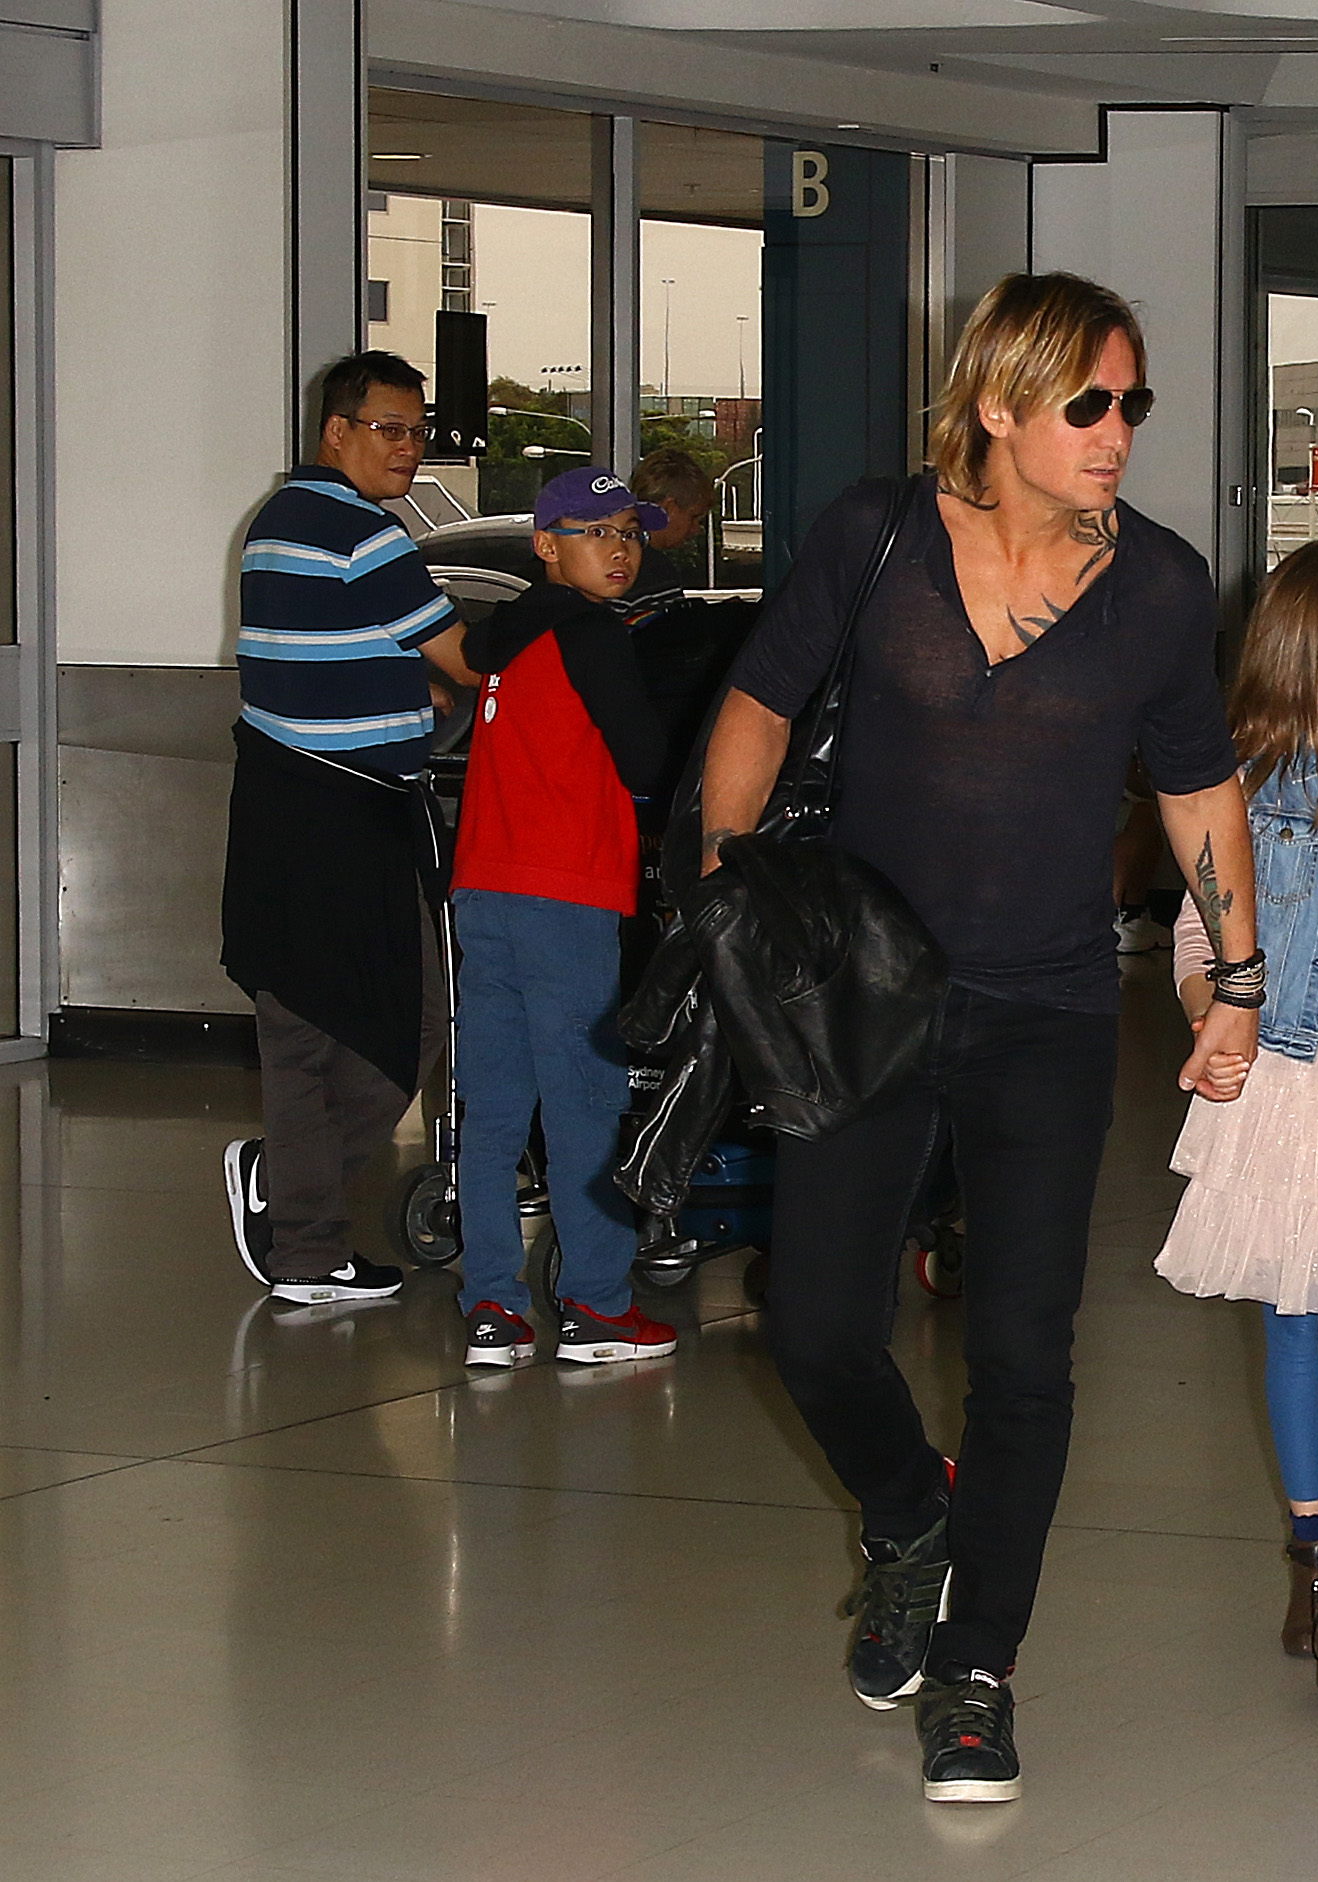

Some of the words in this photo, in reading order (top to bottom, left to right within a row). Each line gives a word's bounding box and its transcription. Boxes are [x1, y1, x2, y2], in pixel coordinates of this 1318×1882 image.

[792, 150, 830, 217] B
[627, 1065, 665, 1080] Sydney
[628, 1077, 662, 1091] Airpor
